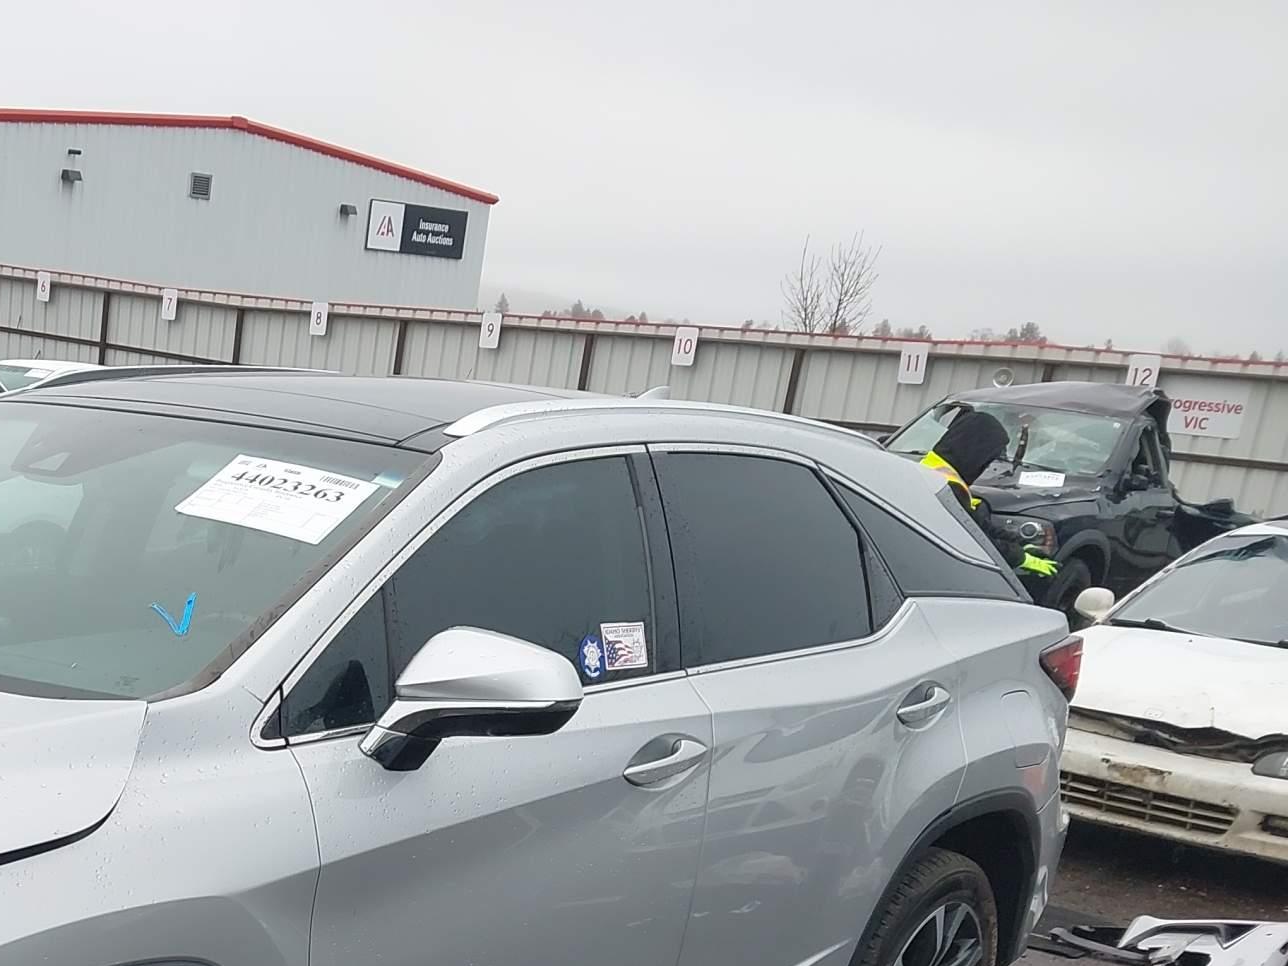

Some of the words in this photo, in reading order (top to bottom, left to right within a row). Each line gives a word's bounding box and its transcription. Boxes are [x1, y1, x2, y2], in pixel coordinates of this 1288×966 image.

[419, 218, 448, 232] Insurance
[412, 231, 426, 242] Auto
[427, 232, 453, 246] Auctions
[167, 298, 173, 311] 7
[315, 312, 322, 326] 8
[487, 322, 494, 338] 9
[677, 338, 693, 354] 10
[906, 354, 920, 372] 11
[1132, 368, 1152, 386] 12
[1184, 416, 1210, 430] VIC
[232, 471, 344, 502] 44023263
